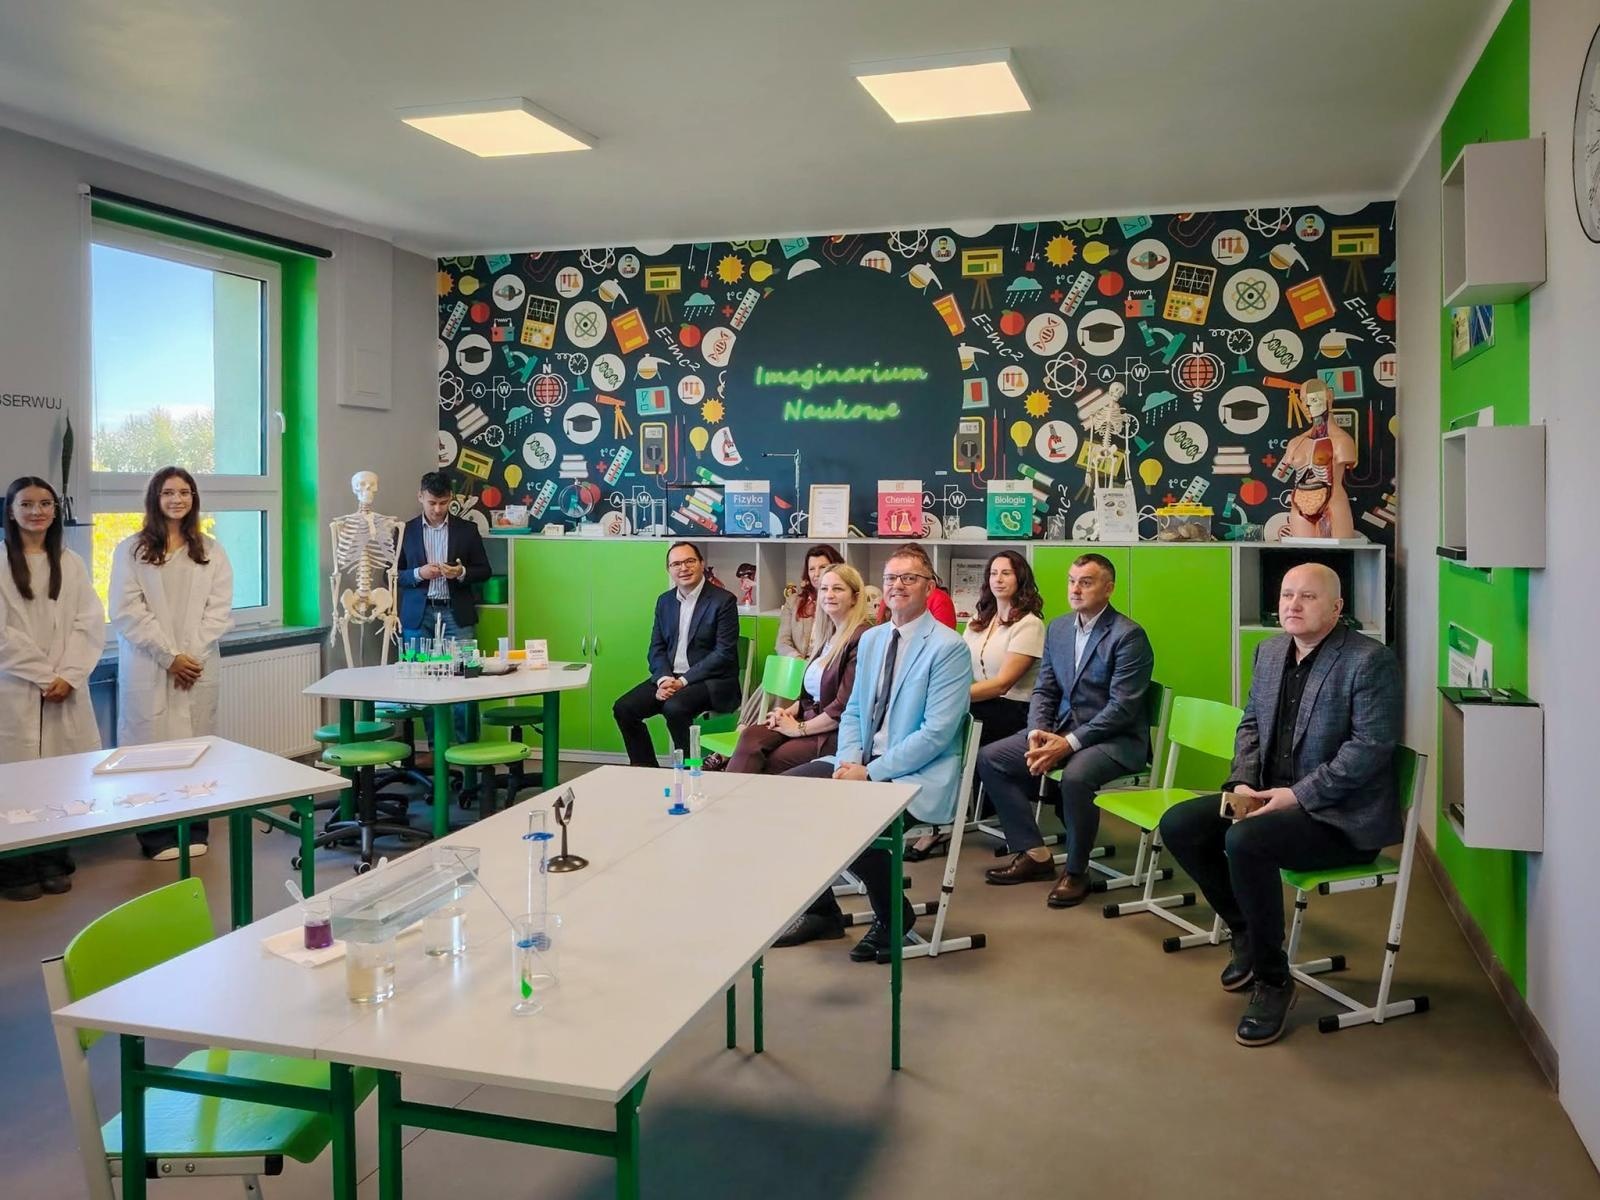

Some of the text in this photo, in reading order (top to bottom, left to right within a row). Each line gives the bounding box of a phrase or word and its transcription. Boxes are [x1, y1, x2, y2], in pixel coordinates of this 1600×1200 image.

[1192, 341, 1204, 353] N
[542, 363, 552, 374] N
[1101, 367, 1147, 379] A W
[755, 361, 929, 390] Imaginarium
[474, 385, 509, 395] A W
[0, 394, 62, 410] SERWUJ
[1192, 391, 1203, 403] S
[543, 407, 552, 417] S
[784, 398, 901, 421] Naukowe
[613, 495, 650, 504] A W
[733, 494, 764, 505] Fizyka
[885, 495, 915, 504] Chemia
[922, 495, 963, 505] A W
[994, 495, 1026, 506] Biologia
